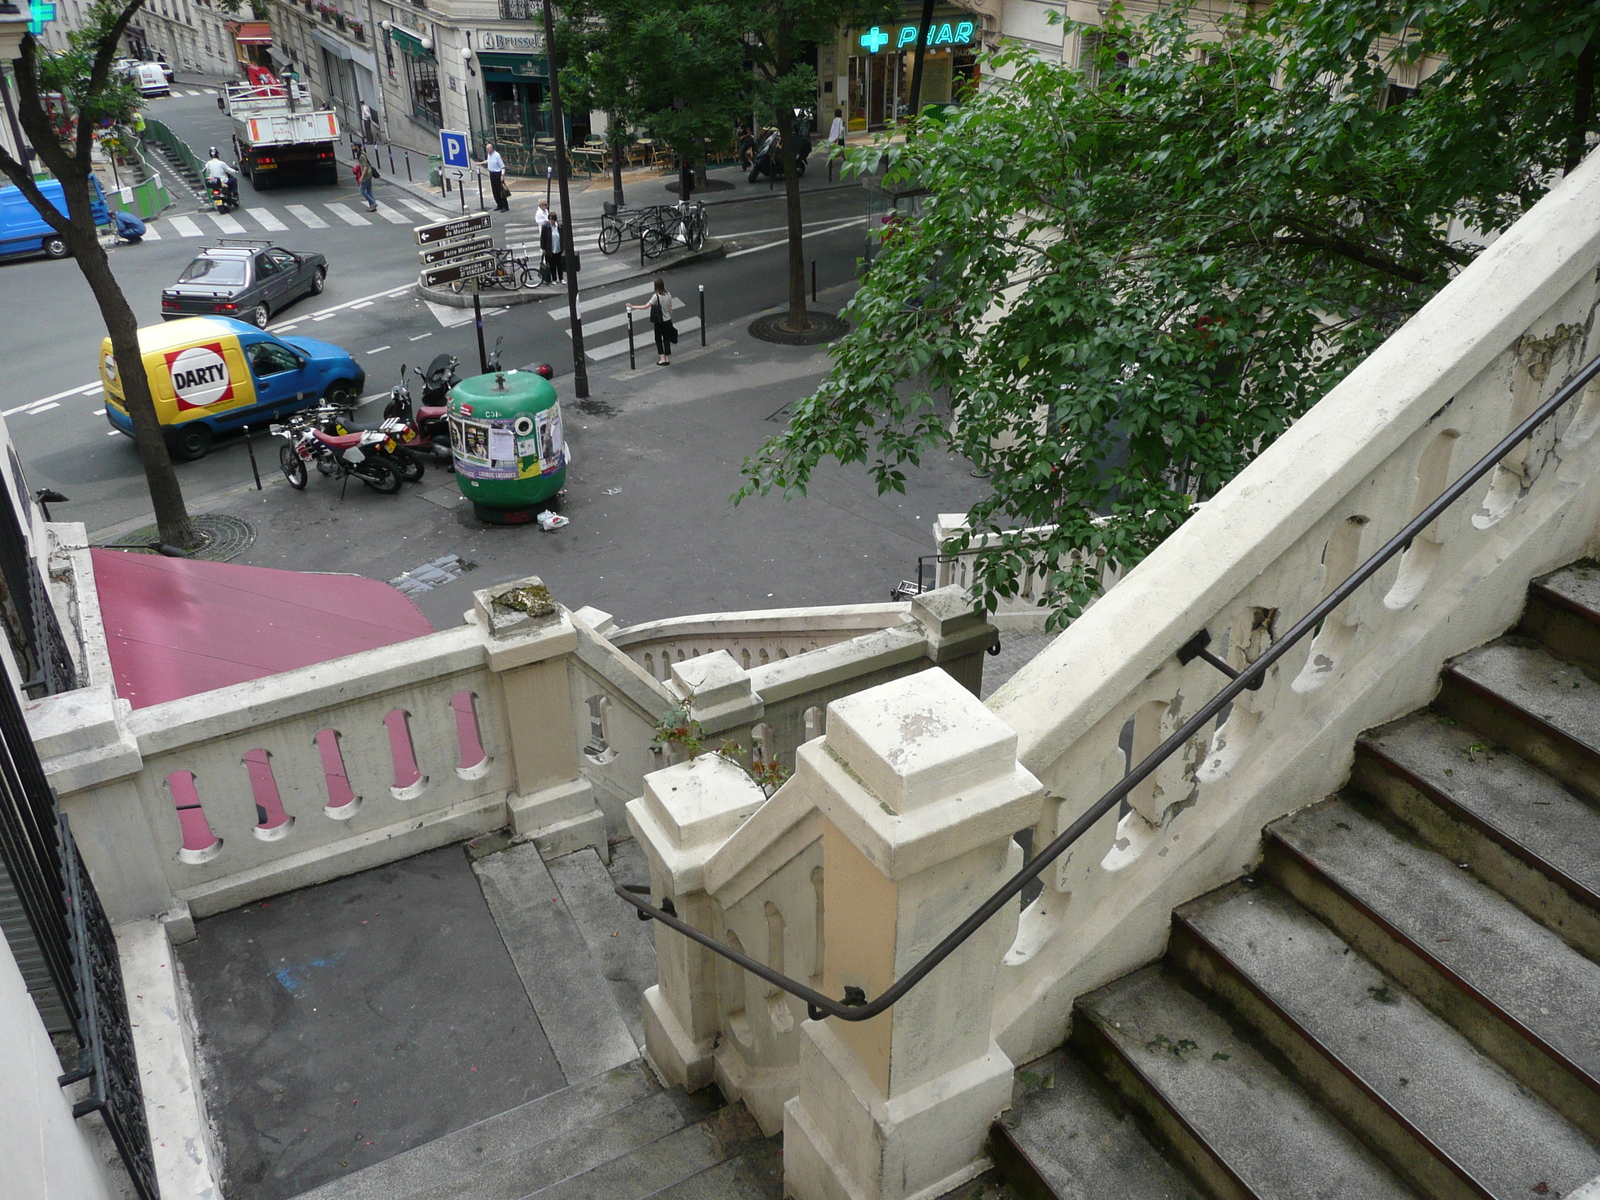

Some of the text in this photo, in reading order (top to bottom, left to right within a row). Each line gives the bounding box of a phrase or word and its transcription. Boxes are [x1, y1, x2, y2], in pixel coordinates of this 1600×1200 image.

[447, 138, 460, 160] P
[453, 224, 482, 235] Montmartre
[173, 363, 224, 390] DARTY
